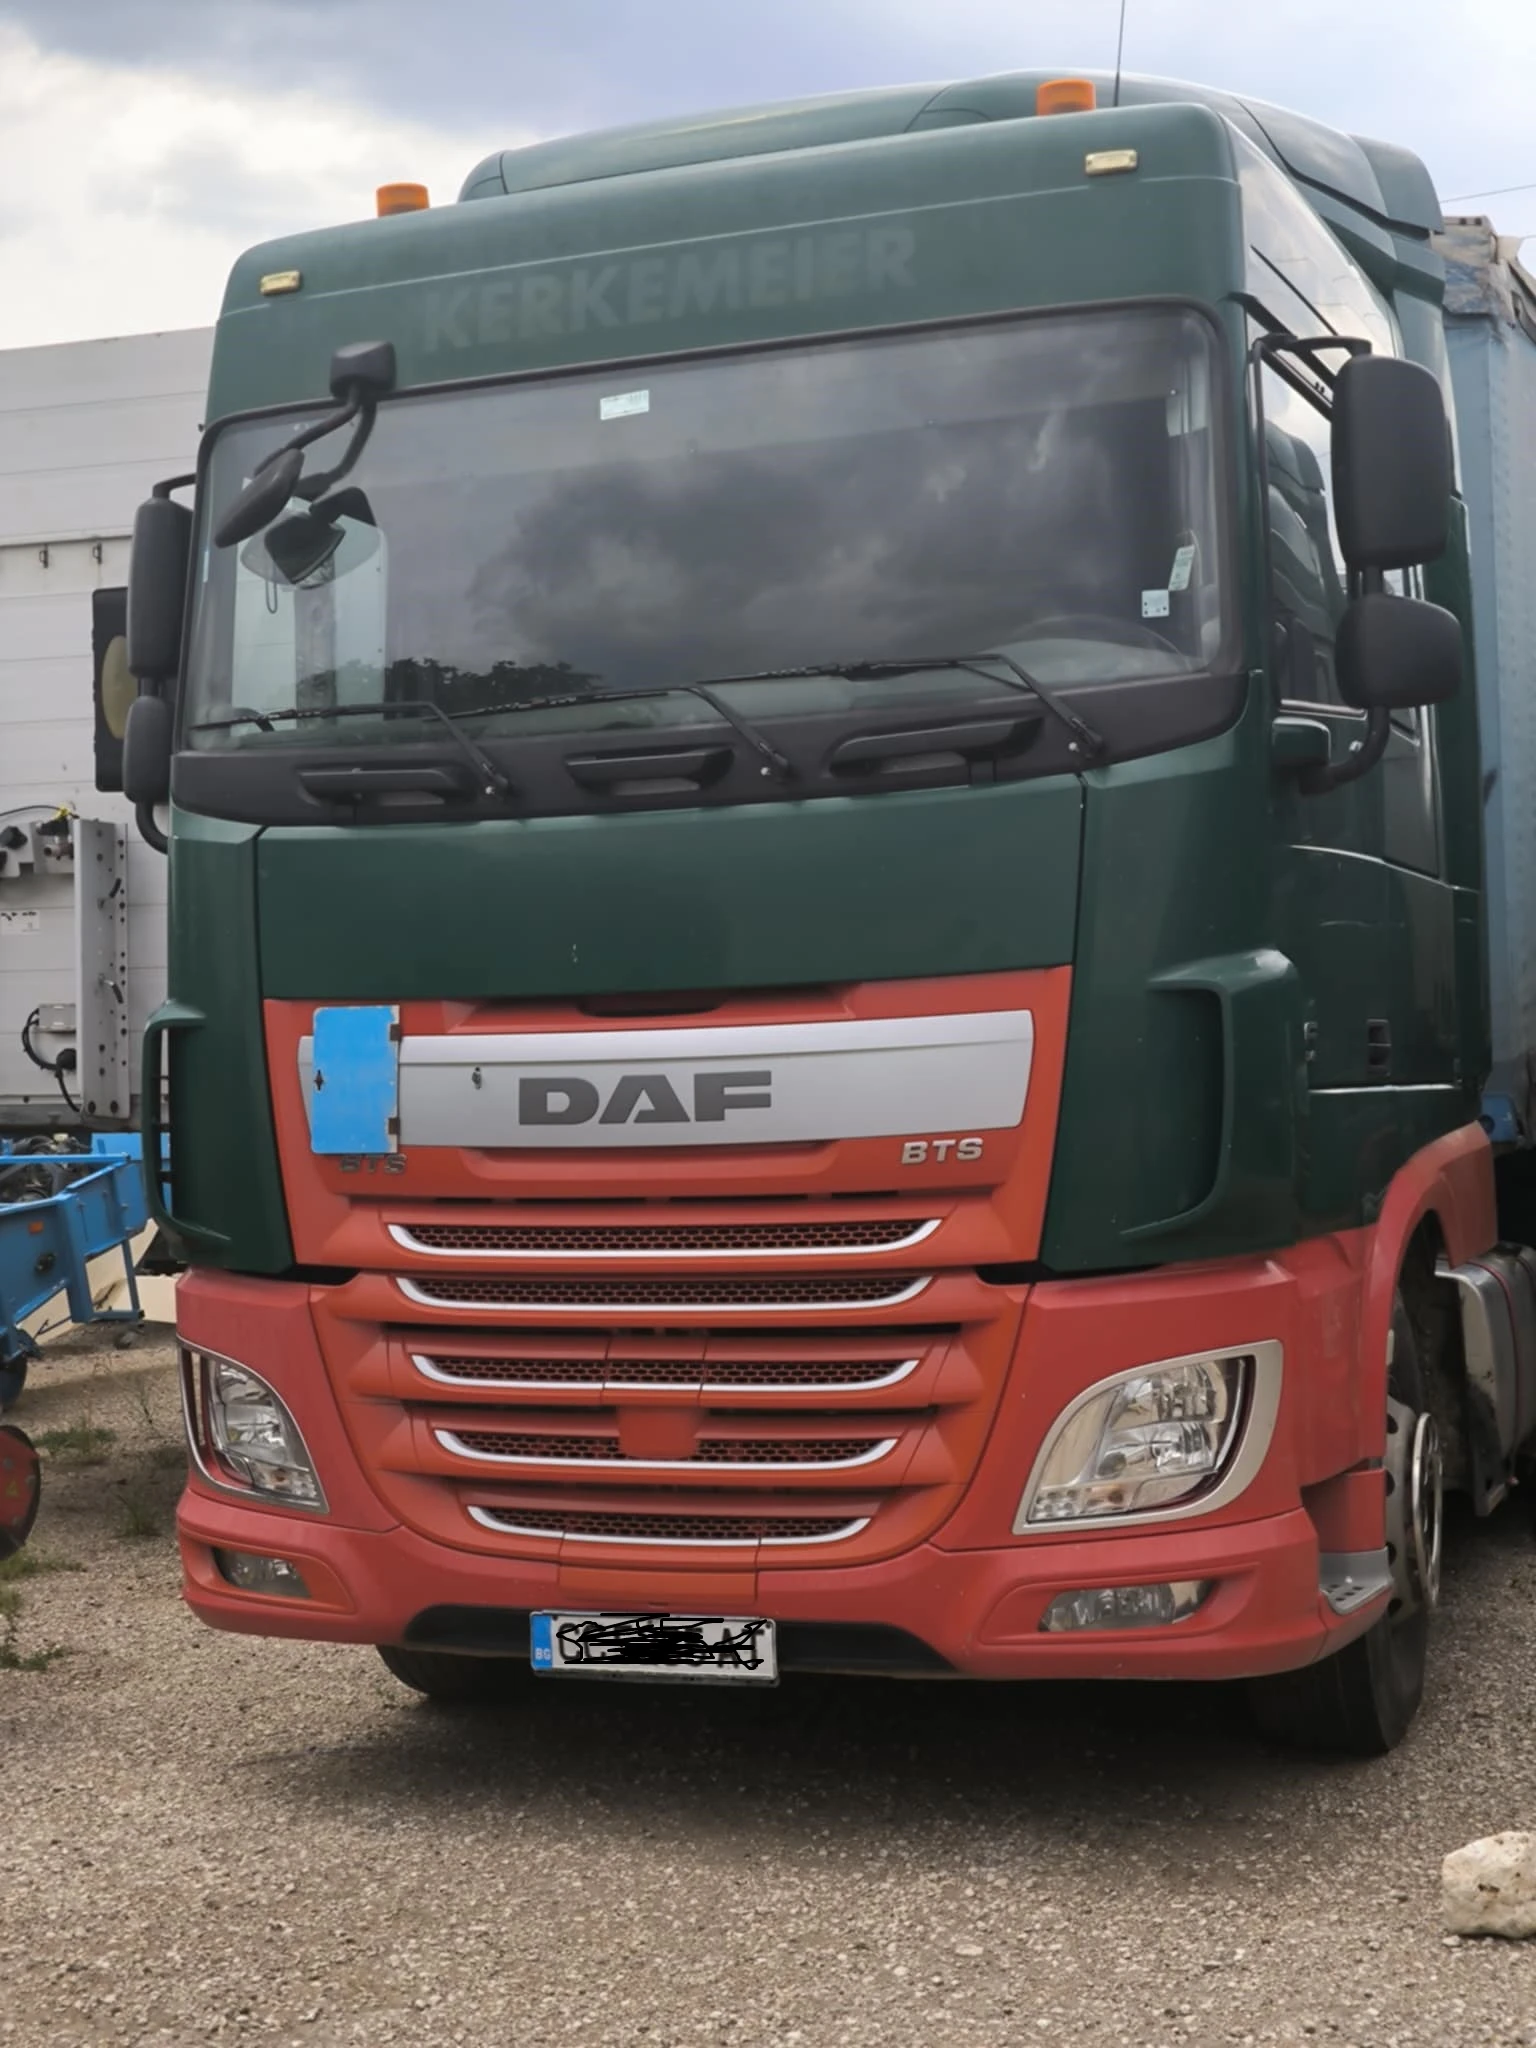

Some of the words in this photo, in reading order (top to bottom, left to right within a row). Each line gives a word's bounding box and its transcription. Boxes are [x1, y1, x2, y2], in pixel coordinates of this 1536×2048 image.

[423, 228, 918, 352] KERKEMEIER
[519, 1071, 772, 1125] DAF
[902, 1138, 983, 1164] BTS
[535, 1647, 551, 1660] BG
